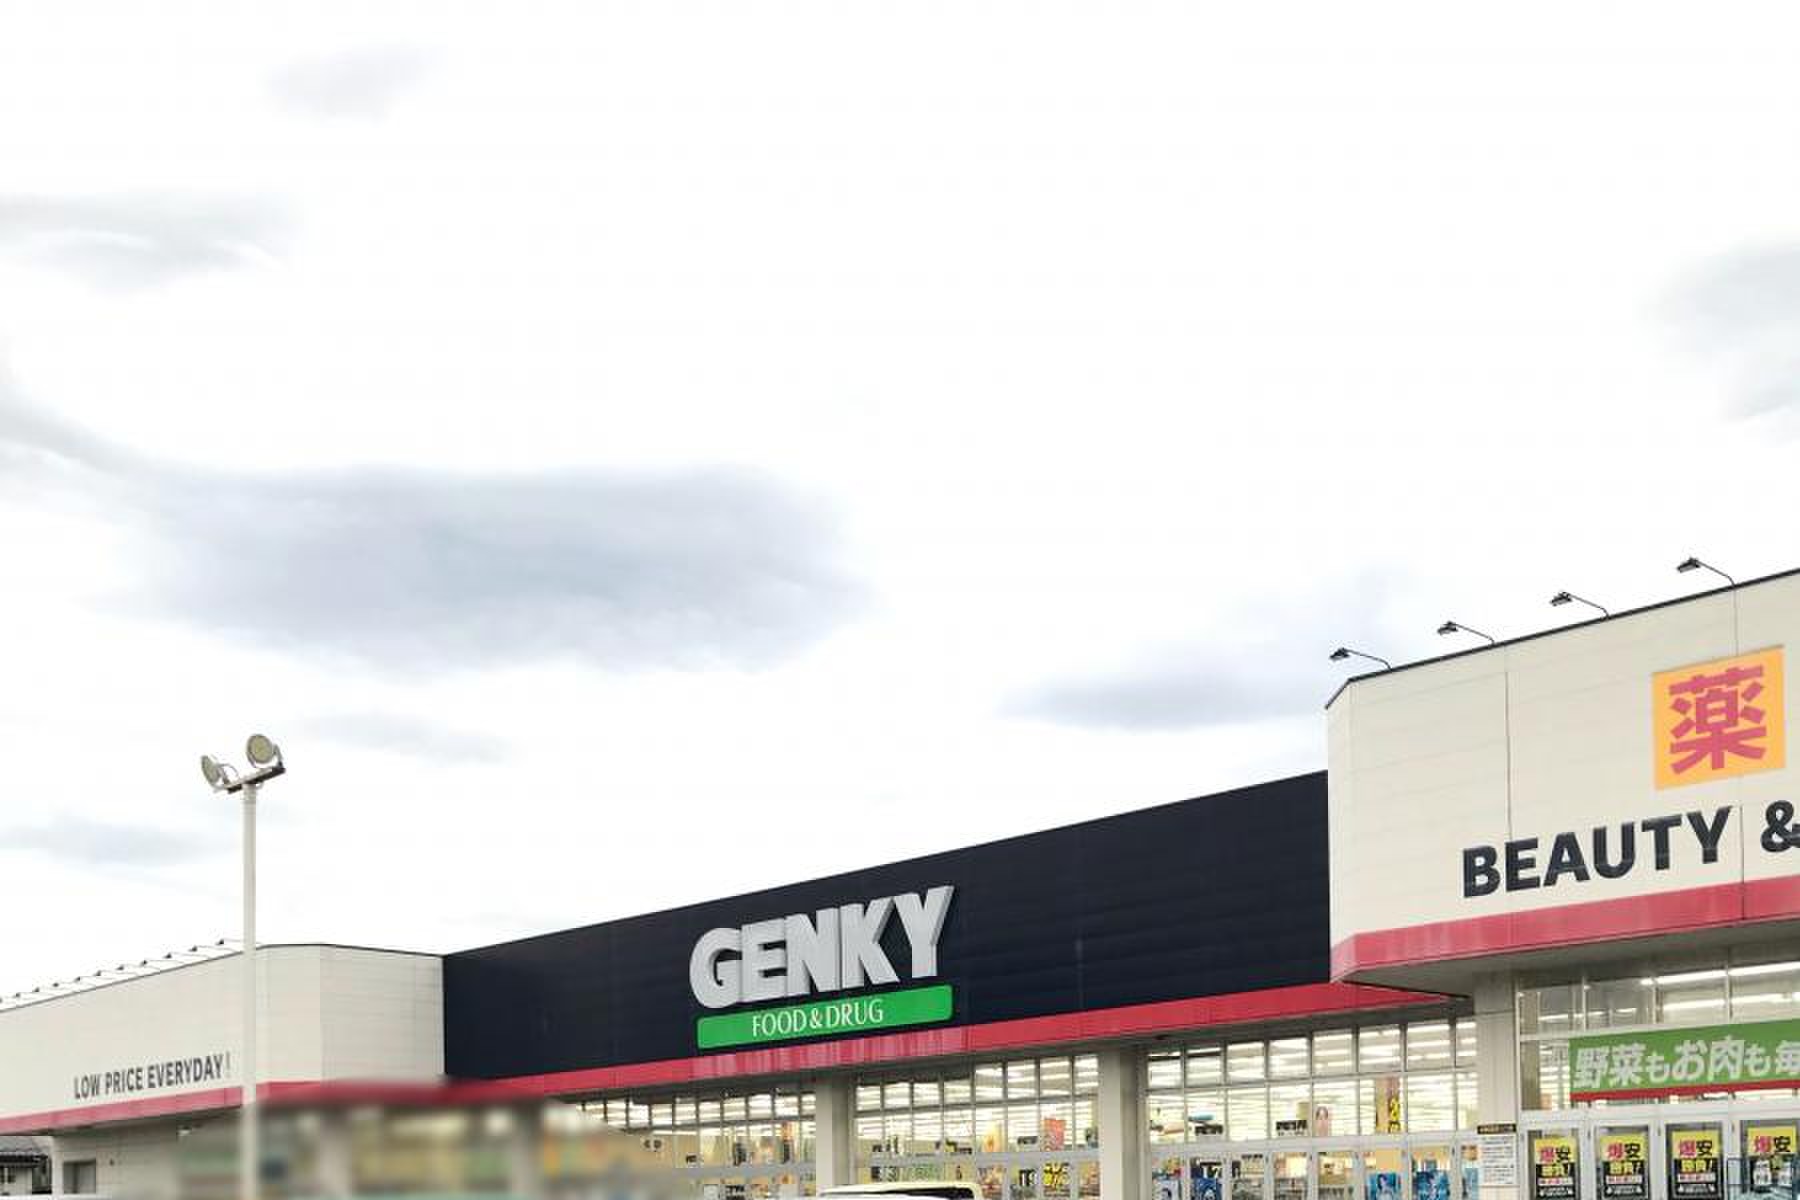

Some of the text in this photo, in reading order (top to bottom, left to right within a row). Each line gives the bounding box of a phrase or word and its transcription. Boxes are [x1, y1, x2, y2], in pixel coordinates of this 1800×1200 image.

[1668, 665, 1767, 774] 薬
[1463, 800, 1800, 898] BEAUTY &
[689, 885, 955, 1009] GENKY
[752, 999, 884, 1037] FOOD&DRUG
[74, 1073, 101, 1099] LOW
[105, 1067, 144, 1094] PRICE
